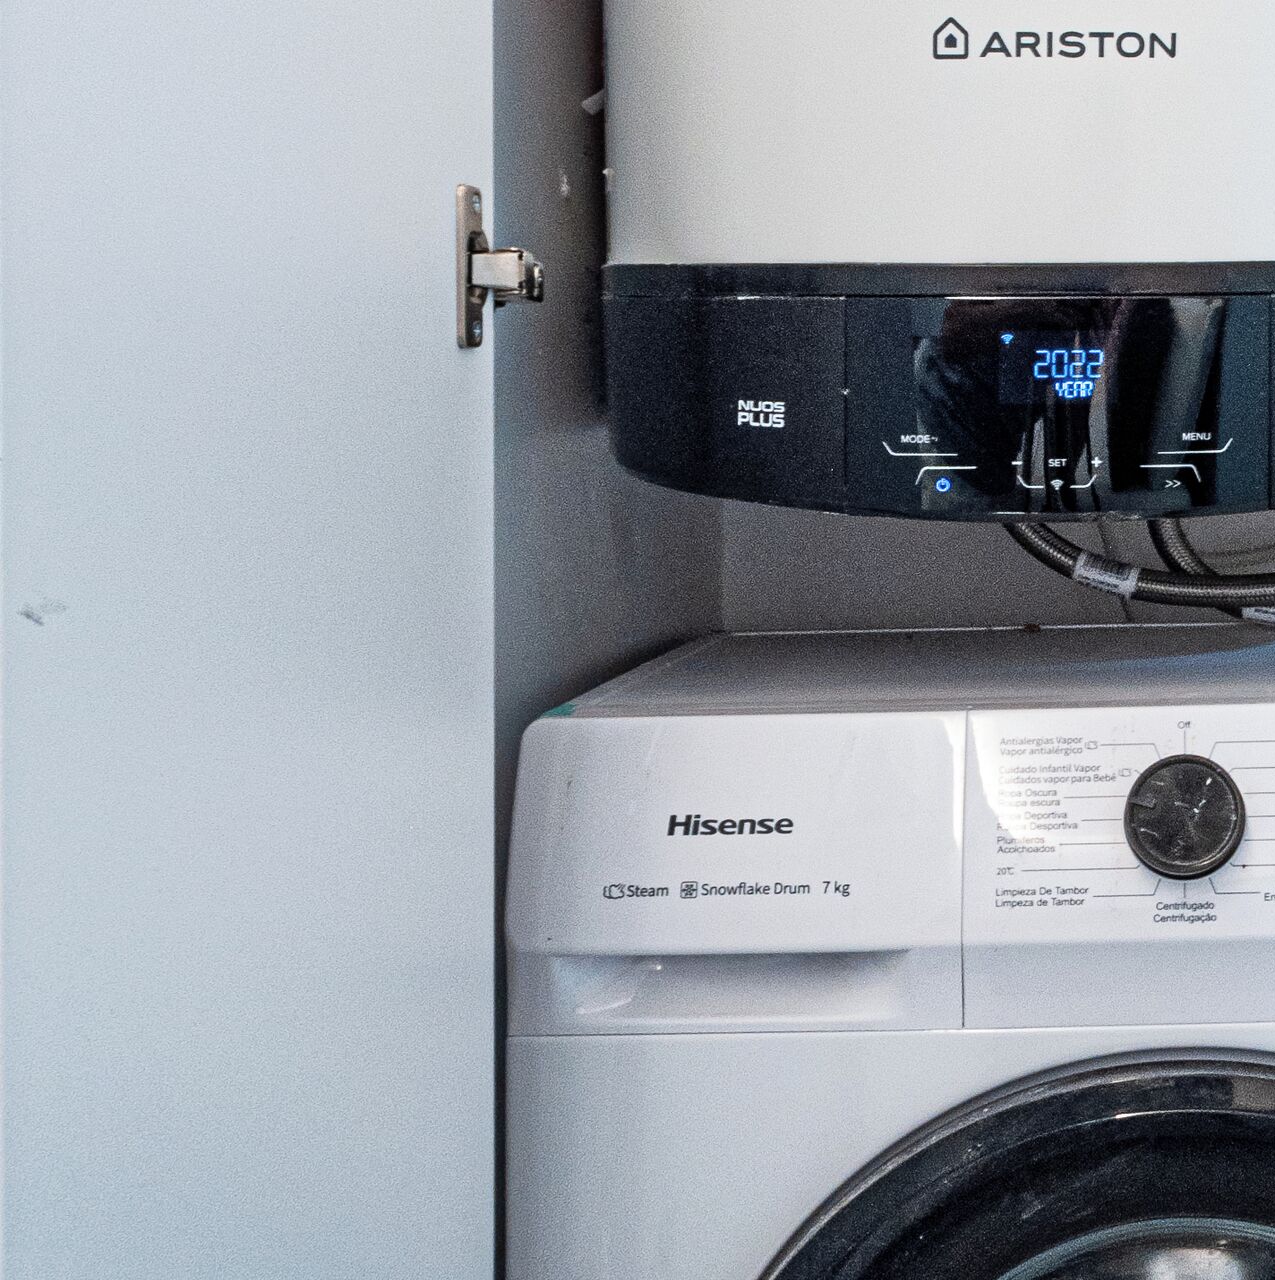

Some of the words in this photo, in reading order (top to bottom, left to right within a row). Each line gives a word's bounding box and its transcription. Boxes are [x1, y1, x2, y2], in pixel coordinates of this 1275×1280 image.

[979, 31, 1177, 58] ARISTON
[1034, 349, 1104, 378] 2022
[1055, 381, 1093, 398] YEAR
[737, 400, 785, 413] NUOS
[737, 413, 785, 428] PLUS
[901, 434, 930, 443] MODE
[1183, 432, 1212, 441] MENU
[1048, 458, 1067, 467] SET
[1056, 736, 1083, 746] Vapor
[1073, 763, 1101, 773] Vapor
[1043, 775, 1071, 785] vapor
[1071, 775, 1091, 784] para
[667, 814, 794, 836] Hisense
[626, 884, 669, 898] Steam
[701, 881, 770, 896] Snowflake
[774, 882, 810, 895] Drum
[822, 881, 831, 894] 7
[834, 881, 851, 897] kg
[995, 888, 1036, 897] Limpieza
[1039, 886, 1052, 895] De
[1055, 886, 1089, 895] Tambor
[995, 898, 1034, 908] Limpeza
[1037, 898, 1048, 907] de
[1051, 897, 1085, 906] Tambor
[1156, 901, 1215, 911] Centrifugado
[1153, 913, 1217, 924] Centrifugação
